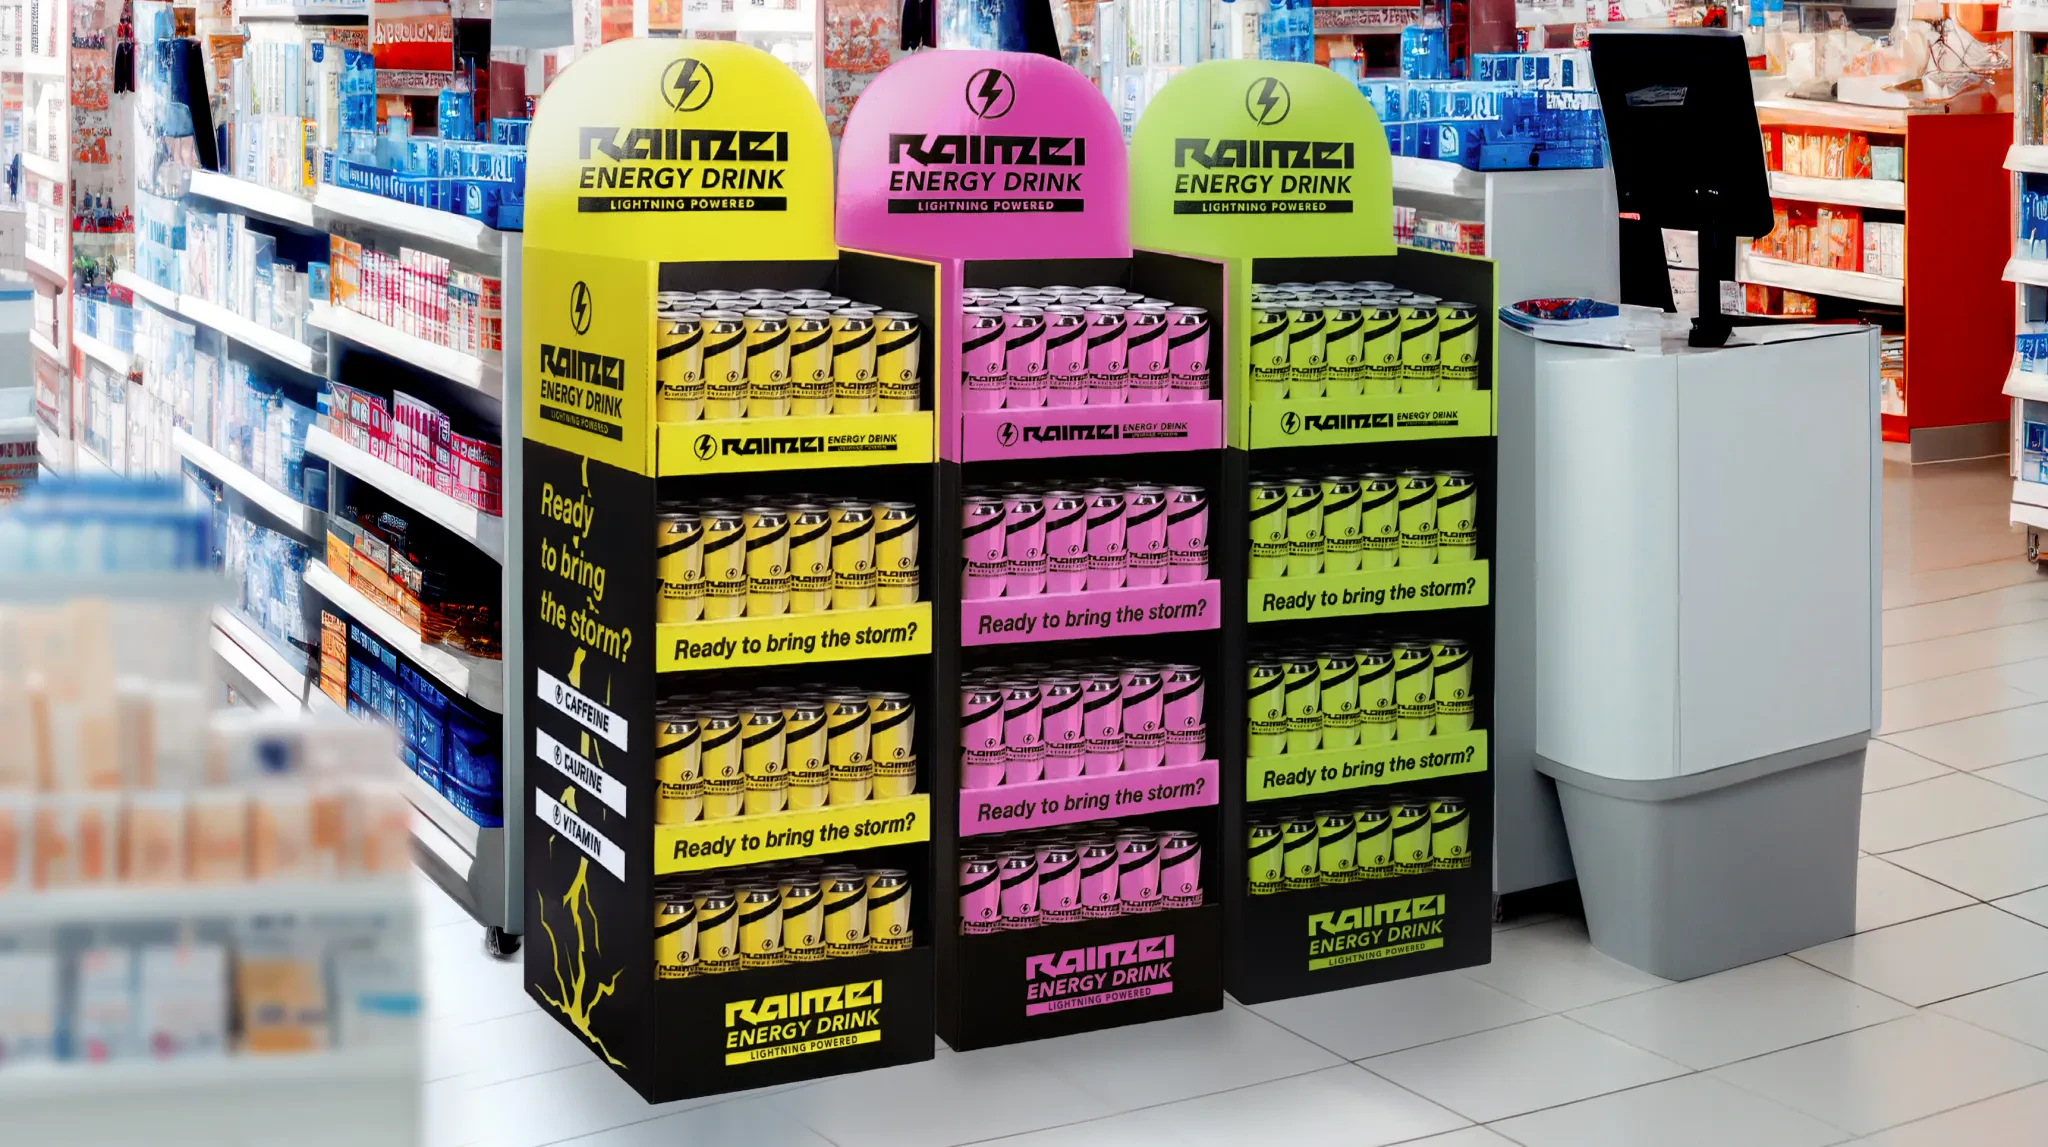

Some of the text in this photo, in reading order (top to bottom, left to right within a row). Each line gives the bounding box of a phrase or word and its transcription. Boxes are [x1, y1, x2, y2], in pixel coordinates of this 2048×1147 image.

[579, 167, 786, 189] ENERGY DRINK
[889, 171, 1083, 192] ENERGY DRINK
[1175, 174, 1352, 193] ENERGY DRINK
[610, 199, 755, 209] LIGHTNING POWERED
[919, 201, 1054, 211] LIGHTNING POWERED
[1203, 203, 1327, 212] LIGHTNING POWERED
[541, 379, 622, 419] ENERGY DRINK
[1397, 412, 1431, 420] ENERGY
[828, 435, 866, 444] ENERGY
[1123, 423, 1158, 432] ENERGY
[541, 482, 594, 538] Ready
[541, 537, 605, 601] to bring
[1262, 577, 1476, 611] Ready to bring the storm?
[541, 590, 632, 663] the storm?
[978, 599, 1206, 634] Ready to bring the storm?
[674, 622, 917, 661] Ready to bring the storm?
[565, 692, 609, 733] CAFFEINE
[1263, 746, 1475, 788] Ready to bring the storm?
[977, 778, 1205, 822] Ready to bring the storm?
[564, 814, 601, 856] VITAMIN
[673, 812, 916, 859] Ready to bring the storm?
[1309, 919, 1443, 955] ENERGY DRINK
[1329, 943, 1426, 966] LIGHTNING POWERED
[1027, 962, 1172, 1000] ENERGY DRINK
[1048, 988, 1152, 1011] LIGHTNING POWERED
[726, 1008, 880, 1048] ENERGY DRINK
[750, 1036, 858, 1060] LIGHTNING POWERED
